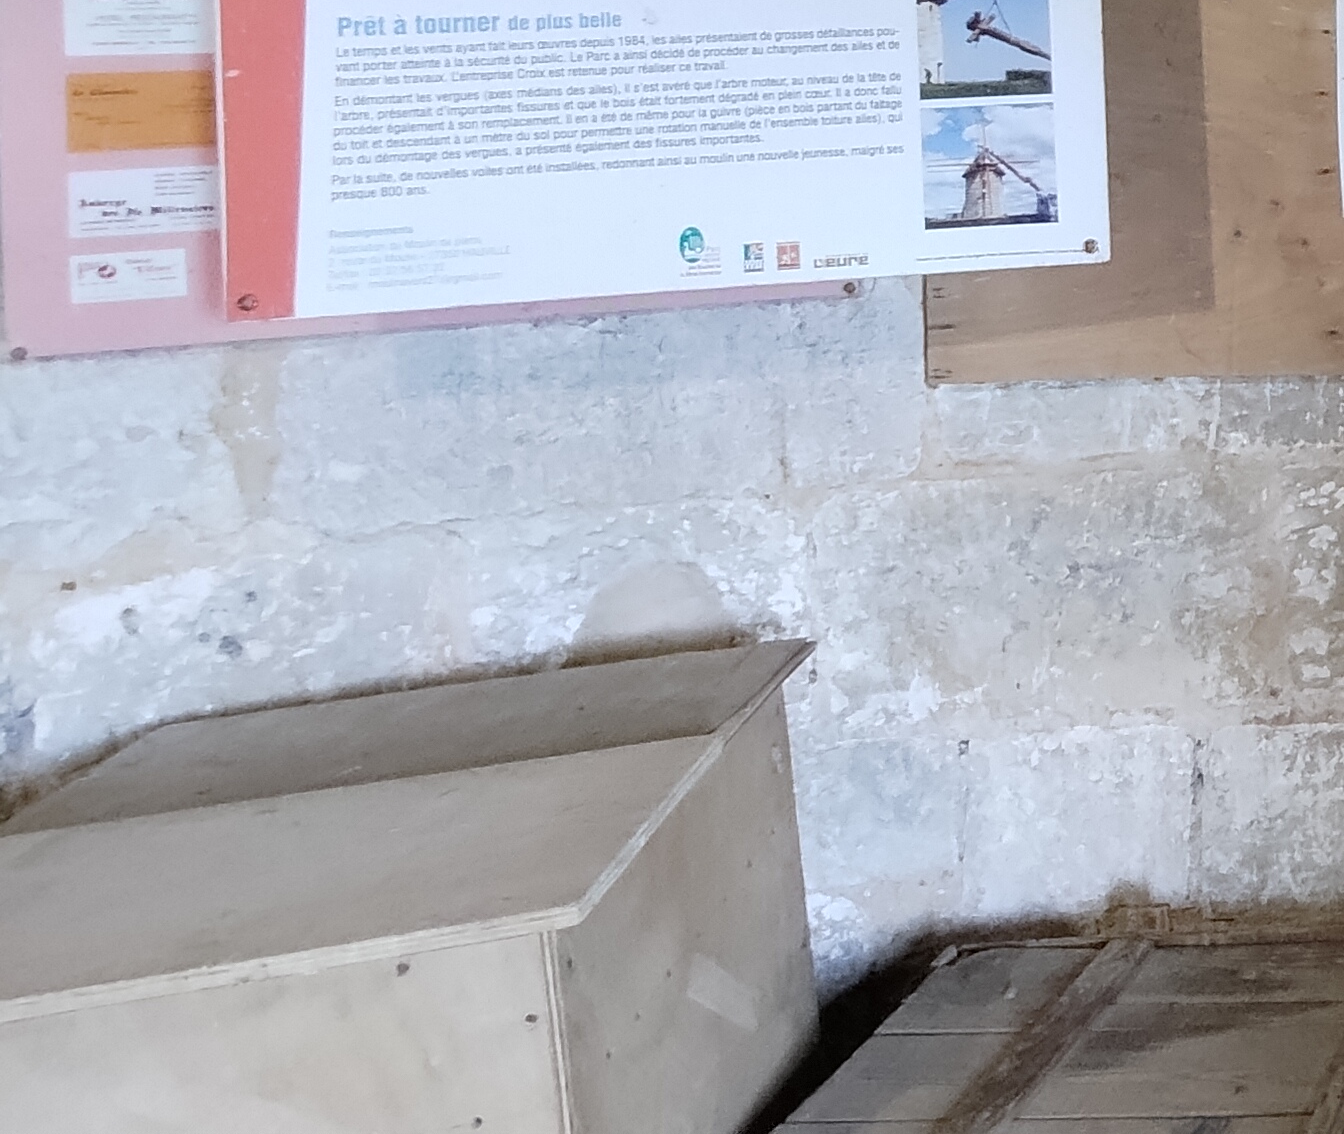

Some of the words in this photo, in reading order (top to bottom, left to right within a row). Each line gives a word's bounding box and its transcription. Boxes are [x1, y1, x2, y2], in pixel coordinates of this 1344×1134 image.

[337, 15, 384, 36] Prêt
[393, 14, 406, 34] à
[415, 11, 498, 33] tourner
[507, 14, 529, 30] de
[536, 13, 572, 34] plus
[578, 11, 621, 28] belle
